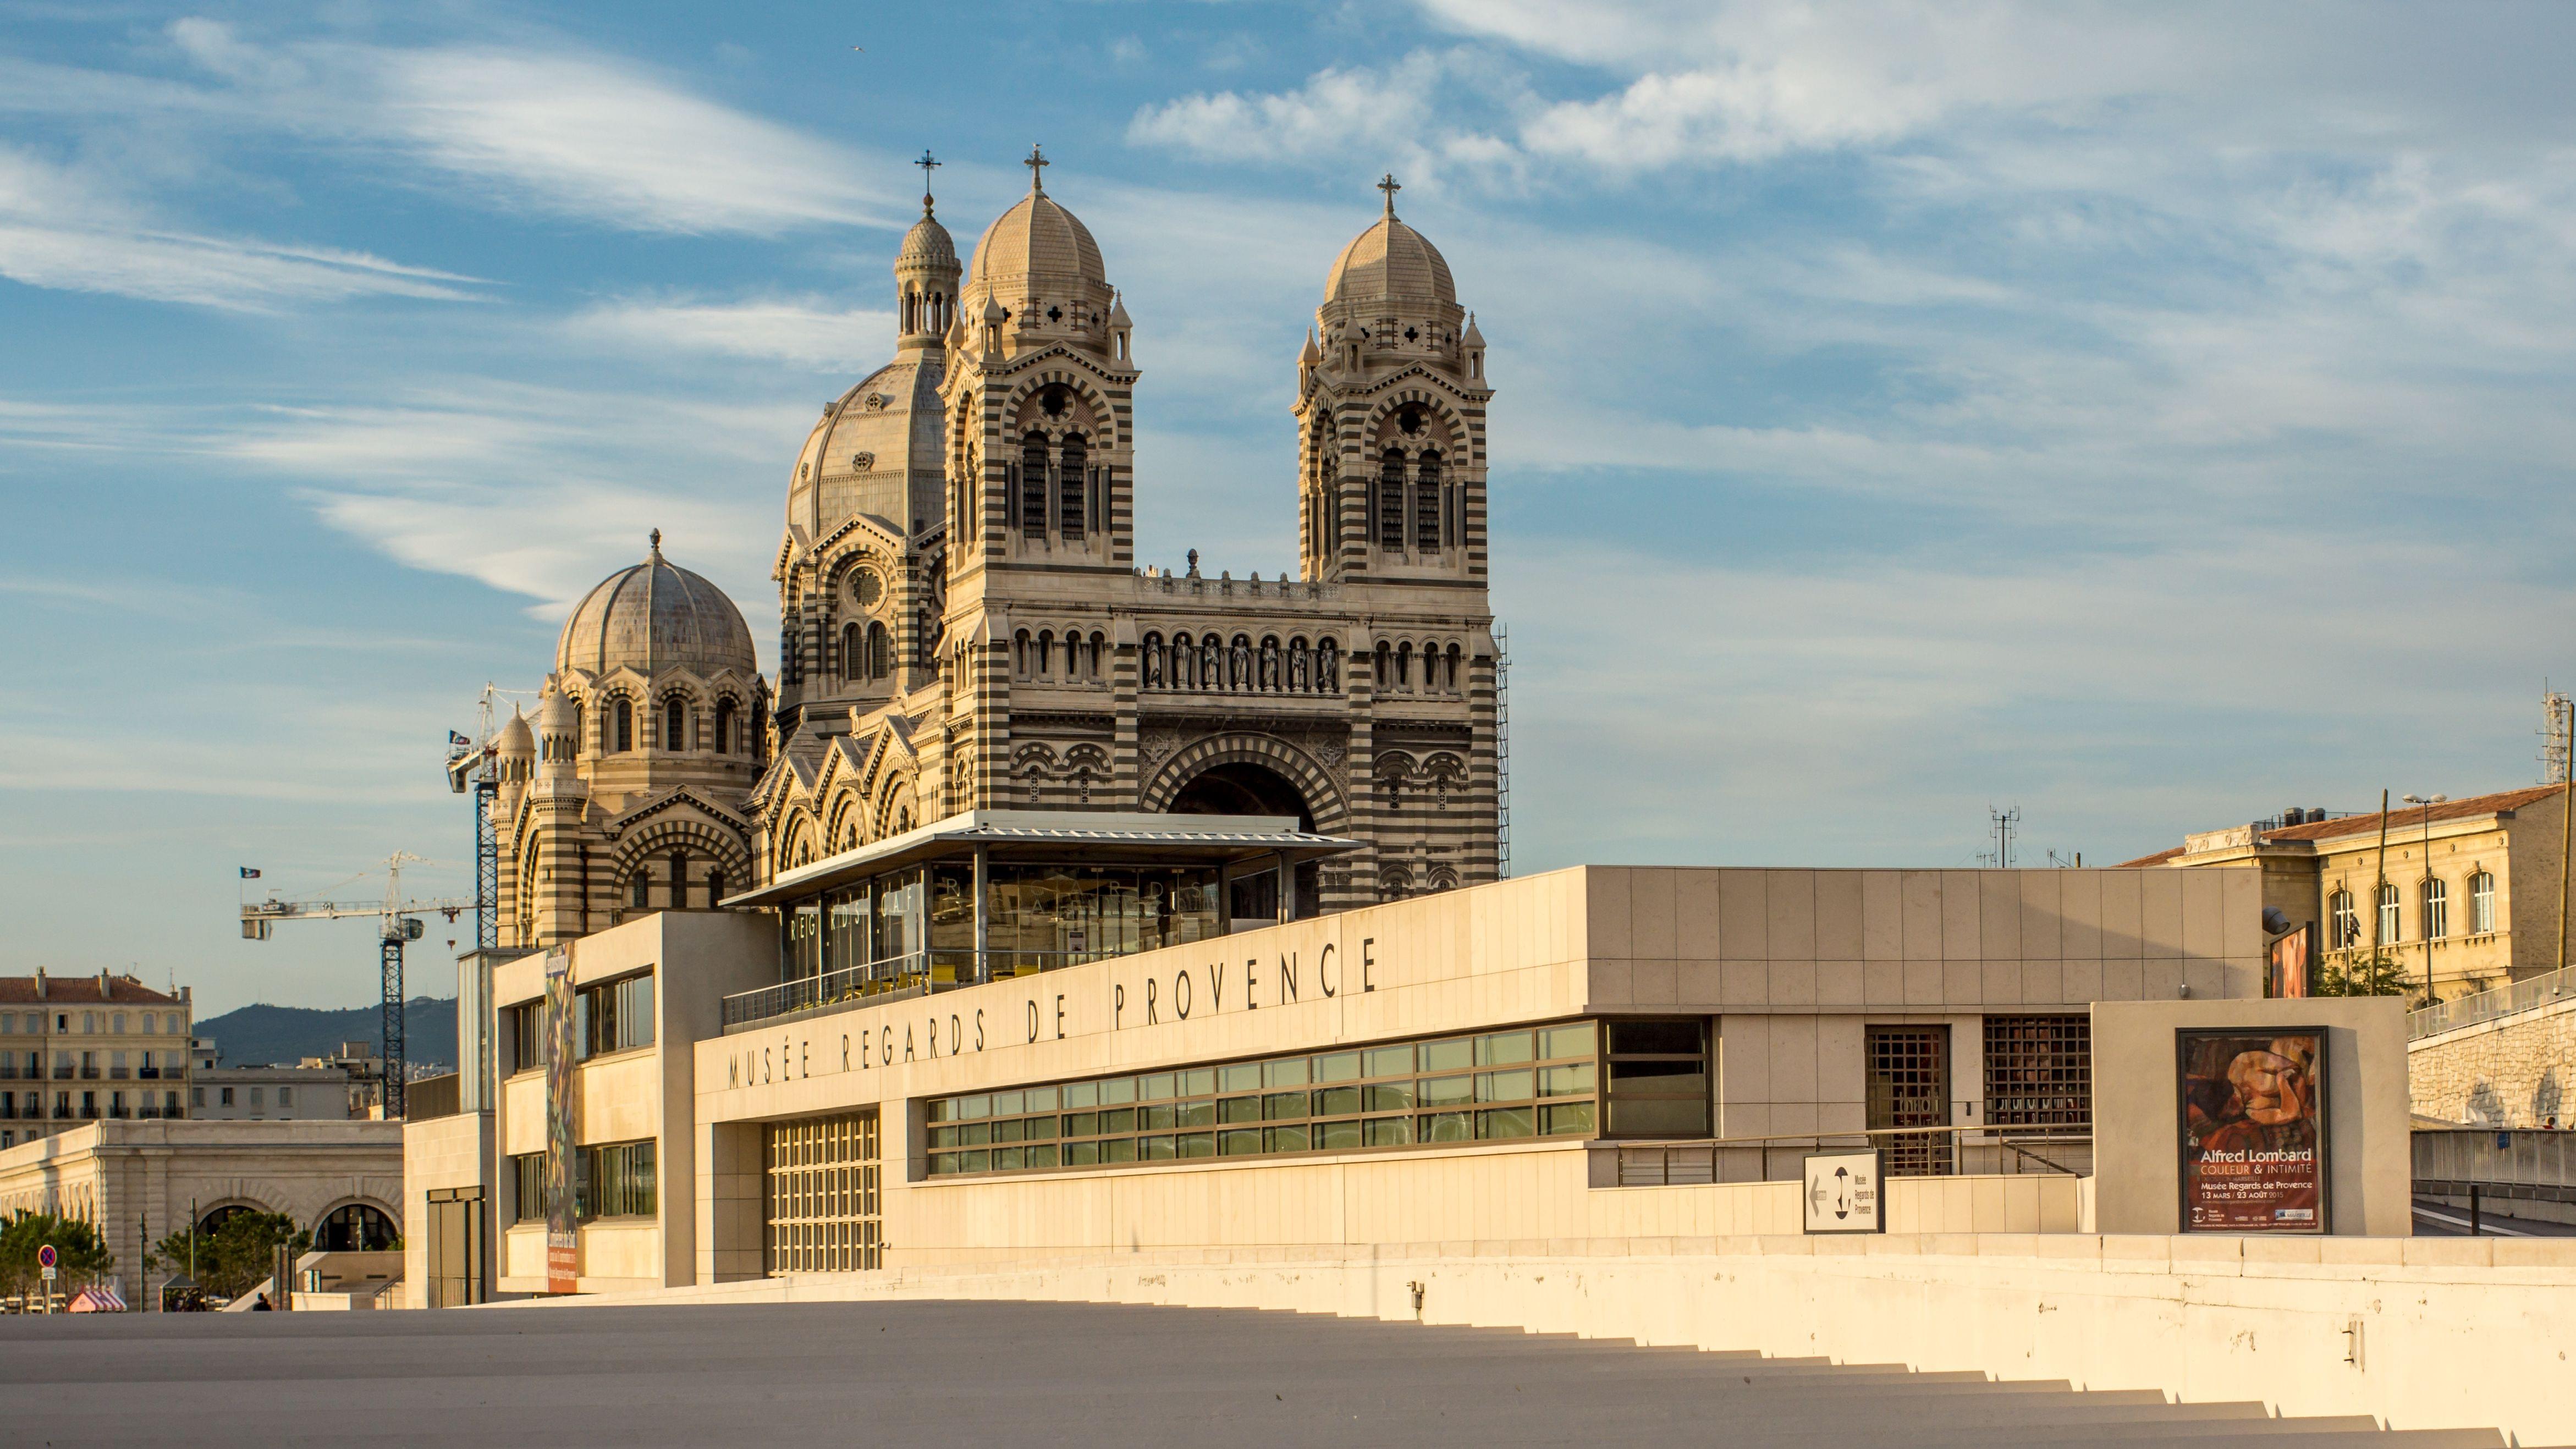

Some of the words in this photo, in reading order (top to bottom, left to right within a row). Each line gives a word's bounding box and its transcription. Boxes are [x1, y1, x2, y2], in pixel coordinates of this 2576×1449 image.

[791, 901, 860, 941] REGRDS
[729, 1035, 809, 1089] MUSÉE
[843, 1008, 984, 1072] REGARDS
[1028, 994, 1065, 1044] DE
[1116, 937, 1375, 1031] PROVENCE
[2200, 1149, 2244, 1163] Alfred
[2249, 1148, 2311, 1162] Lombard
[2201, 1165, 2249, 1175] COULEUR
[2254, 1164, 2262, 1174] &
[2267, 1162, 2311, 1173] INTIMITÉ
[1854, 1175, 1867, 1185] Musée
[2201, 1182, 2227, 1190] Musée
[2229, 1182, 2261, 1191] Regards
[1854, 1189, 1869, 1202] Regards
[1870, 1189, 1874, 1199] de
[1854, 1204, 1871, 1215] Provence
